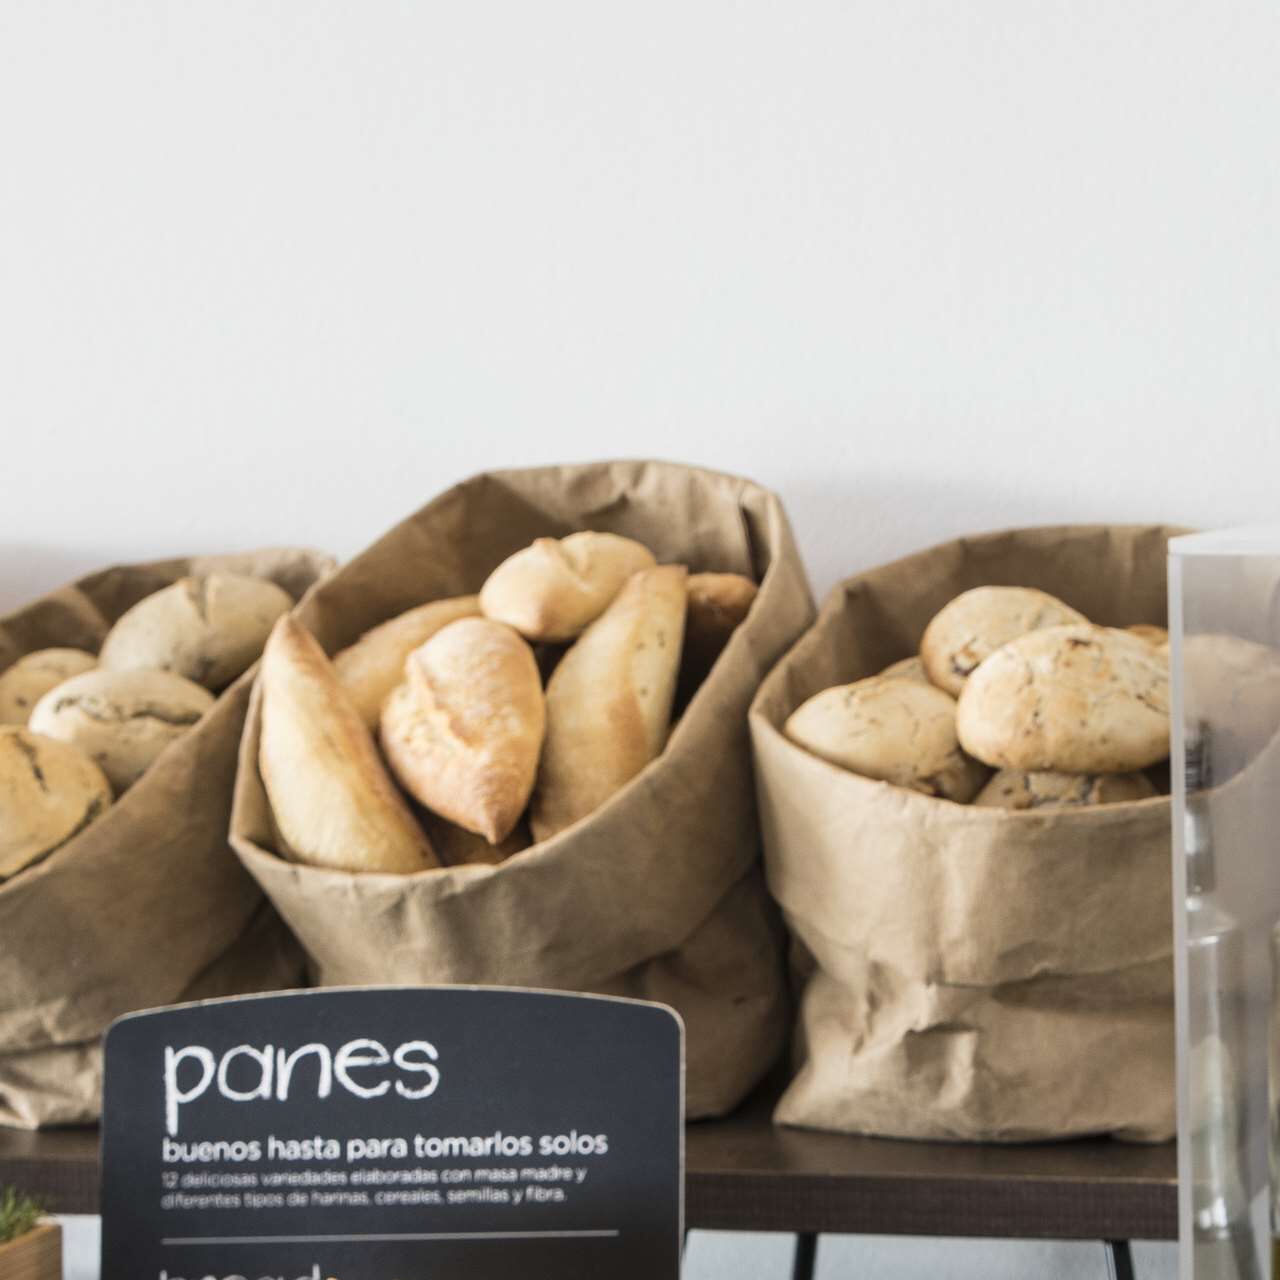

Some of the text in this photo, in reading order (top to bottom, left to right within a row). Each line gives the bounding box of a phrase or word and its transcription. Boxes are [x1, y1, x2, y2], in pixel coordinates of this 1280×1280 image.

[165, 1038, 440, 1137] panes
[162, 1129, 609, 1163] buenos hasta para tomarlos solos
[180, 1170, 258, 1188] deliciosas
[260, 1168, 348, 1187] variedades
[350, 1166, 439, 1186] elaboradas
[440, 1168, 472, 1184] con
[473, 1167, 518, 1184] masa
[520, 1164, 573, 1183] madre
[575, 1166, 588, 1184] y
[160, 1191, 241, 1209] diferentes
[242, 1191, 284, 1209] tipos
[286, 1190, 308, 1207] de
[446, 1186, 510, 1204] semillas
[512, 1189, 524, 1206] y
